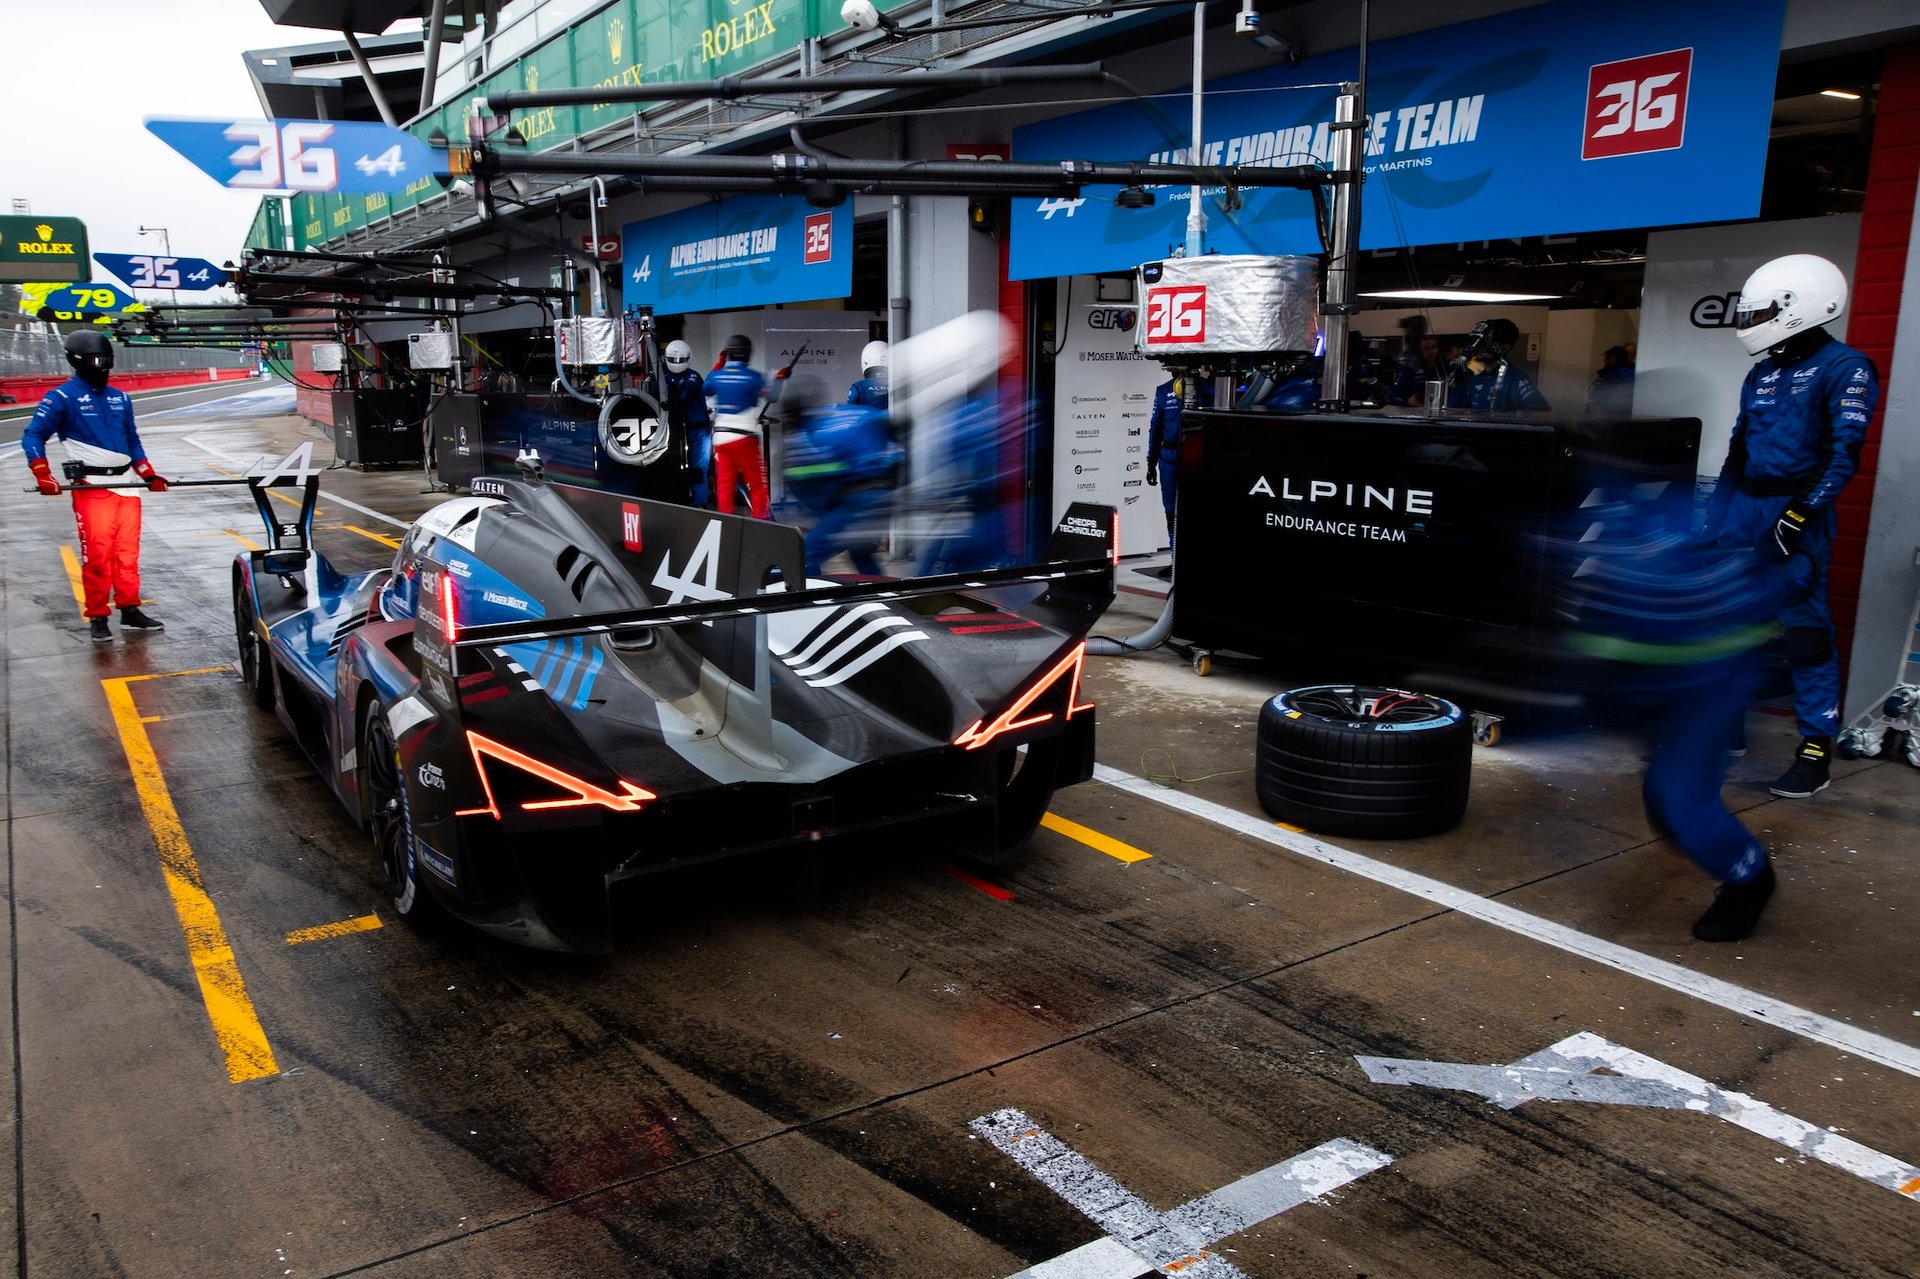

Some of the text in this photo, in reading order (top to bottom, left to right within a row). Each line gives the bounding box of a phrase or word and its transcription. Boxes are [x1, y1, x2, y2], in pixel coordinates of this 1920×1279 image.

[701, 1, 777, 64] ROLEX
[1591, 71, 1682, 139] 36
[1396, 94, 1485, 153] TEAM
[222, 121, 340, 191] 36
[1379, 157, 1433, 173] MARTINS
[18, 242, 75, 254] ROLEX
[670, 242, 697, 268] ALPINE
[697, 231, 750, 264] ENDURANCE
[750, 226, 778, 255] TEAM
[806, 223, 829, 254] 35
[128, 256, 181, 289] 35
[70, 289, 116, 308] 79
[1088, 309, 1120, 329] elf
[1148, 292, 1204, 337] 36
[542, 421, 576, 432] ALPINE
[474, 483, 505, 495] ALTEN
[1249, 475, 1434, 515] ALPINE
[624, 512, 640, 543] HY
[1060, 524, 1107, 538] TECHNOLOGY
[1067, 517, 1097, 528] CHEOPS
[1266, 513, 1406, 543] ENDURANCE TEAM
